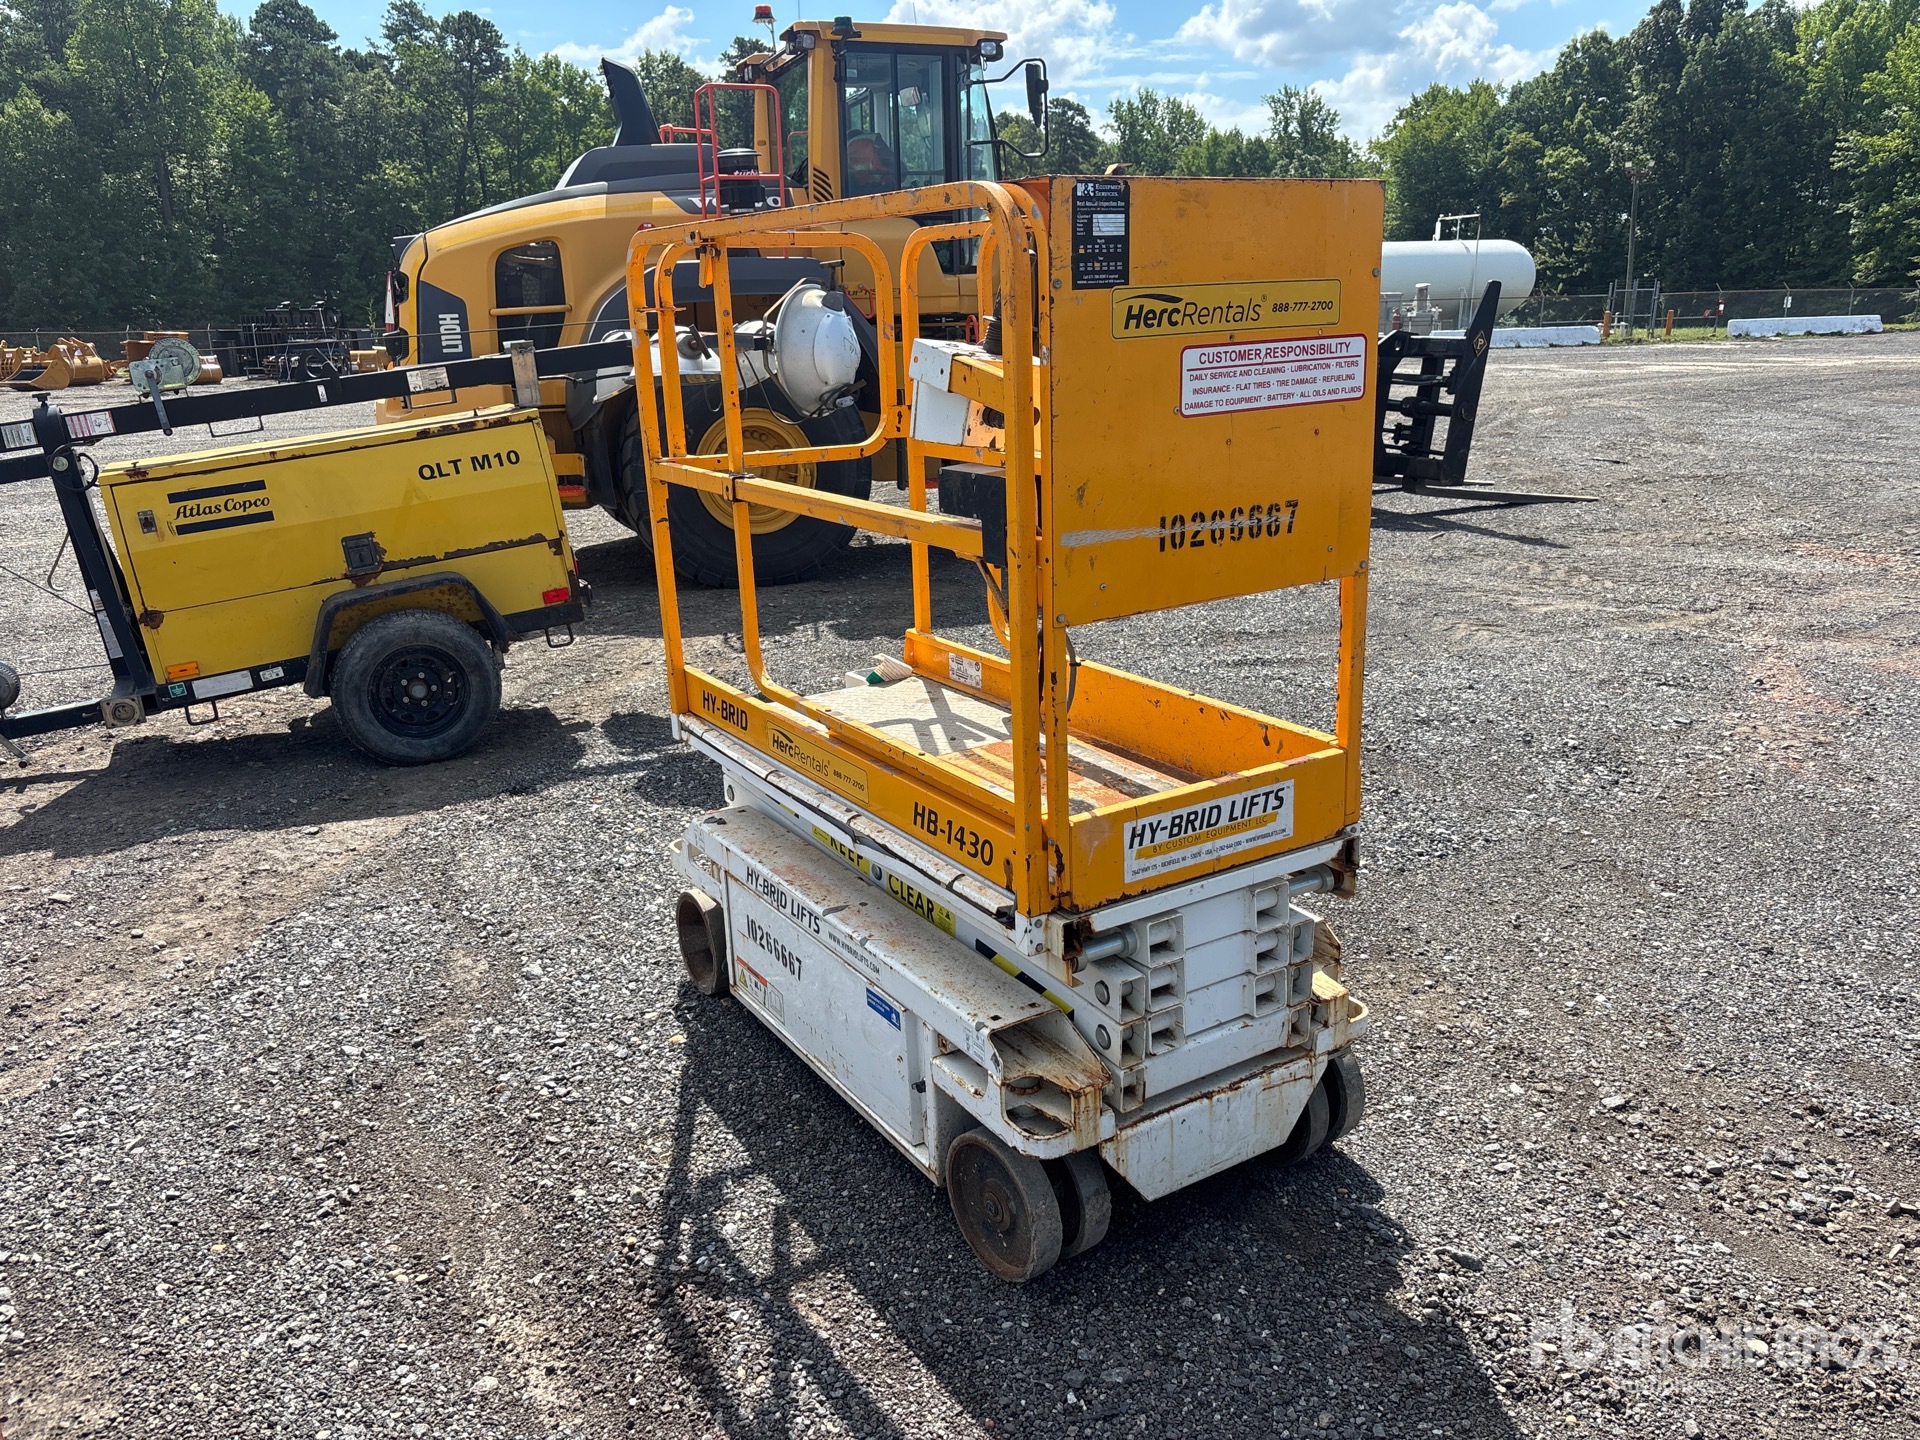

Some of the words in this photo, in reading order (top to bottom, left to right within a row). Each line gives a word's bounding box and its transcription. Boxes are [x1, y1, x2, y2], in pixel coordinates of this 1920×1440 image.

[1272, 300, 1334, 312] 888-777-2700
[438, 314, 463, 352] L110H
[1189, 373, 1208, 382] DAILY
[1210, 370, 1238, 380] SERVICE
[1239, 368, 1252, 377] AND
[1254, 366, 1286, 376] CLEANING
[1290, 362, 1331, 373] LUBRICATION
[1336, 360, 1359, 369] FILTERS
[1199, 348, 1262, 364] CUSTOMER
[1265, 342, 1352, 359] RESPONSIBILITY
[1184, 400, 1214, 410] DAMAGE
[1215, 399, 1224, 407] TO
[1225, 396, 1262, 406] EQUIPMENT
[1268, 392, 1296, 402] BATTERY
[1300, 390, 1311, 398] ALL
[1312, 388, 1326, 397] OILS
[1327, 388, 1340, 396] AND
[1340, 386, 1362, 394] FLUIDS
[1192, 386, 1230, 396] INSURANCE
[1236, 382, 1252, 392] FLAT
[1253, 380, 1271, 390] TIRES
[1276, 378, 1290, 388] TIRE
[1291, 377, 1318, 386] DAMAGE
[1322, 374, 1356, 382] REFUELING
[418, 458, 462, 480] QLT
[470, 450, 520, 472] M10
[173, 504, 222, 520] Atlas
[224, 497, 270, 512] Copco
[1159, 499, 1298, 552] 10266667
[702, 690, 748, 732] HY-BRID
[832, 770, 865, 792] 888-777-2700
[913, 801, 994, 866] HB-1430
[1128, 804, 1222, 850] HY-BRID
[1228, 787, 1285, 823] LIFTS
[1153, 843, 1165, 853] BY
[1166, 834, 1201, 850] CUSTOM
[1206, 822, 1251, 838] EQUIPMENT
[1256, 815, 1268, 825] LLC
[746, 866, 787, 910] HY-BRID
[790, 899, 820, 934] LIFTS
[888, 874, 934, 922] CLEAR
[746, 914, 802, 982] 10266667
